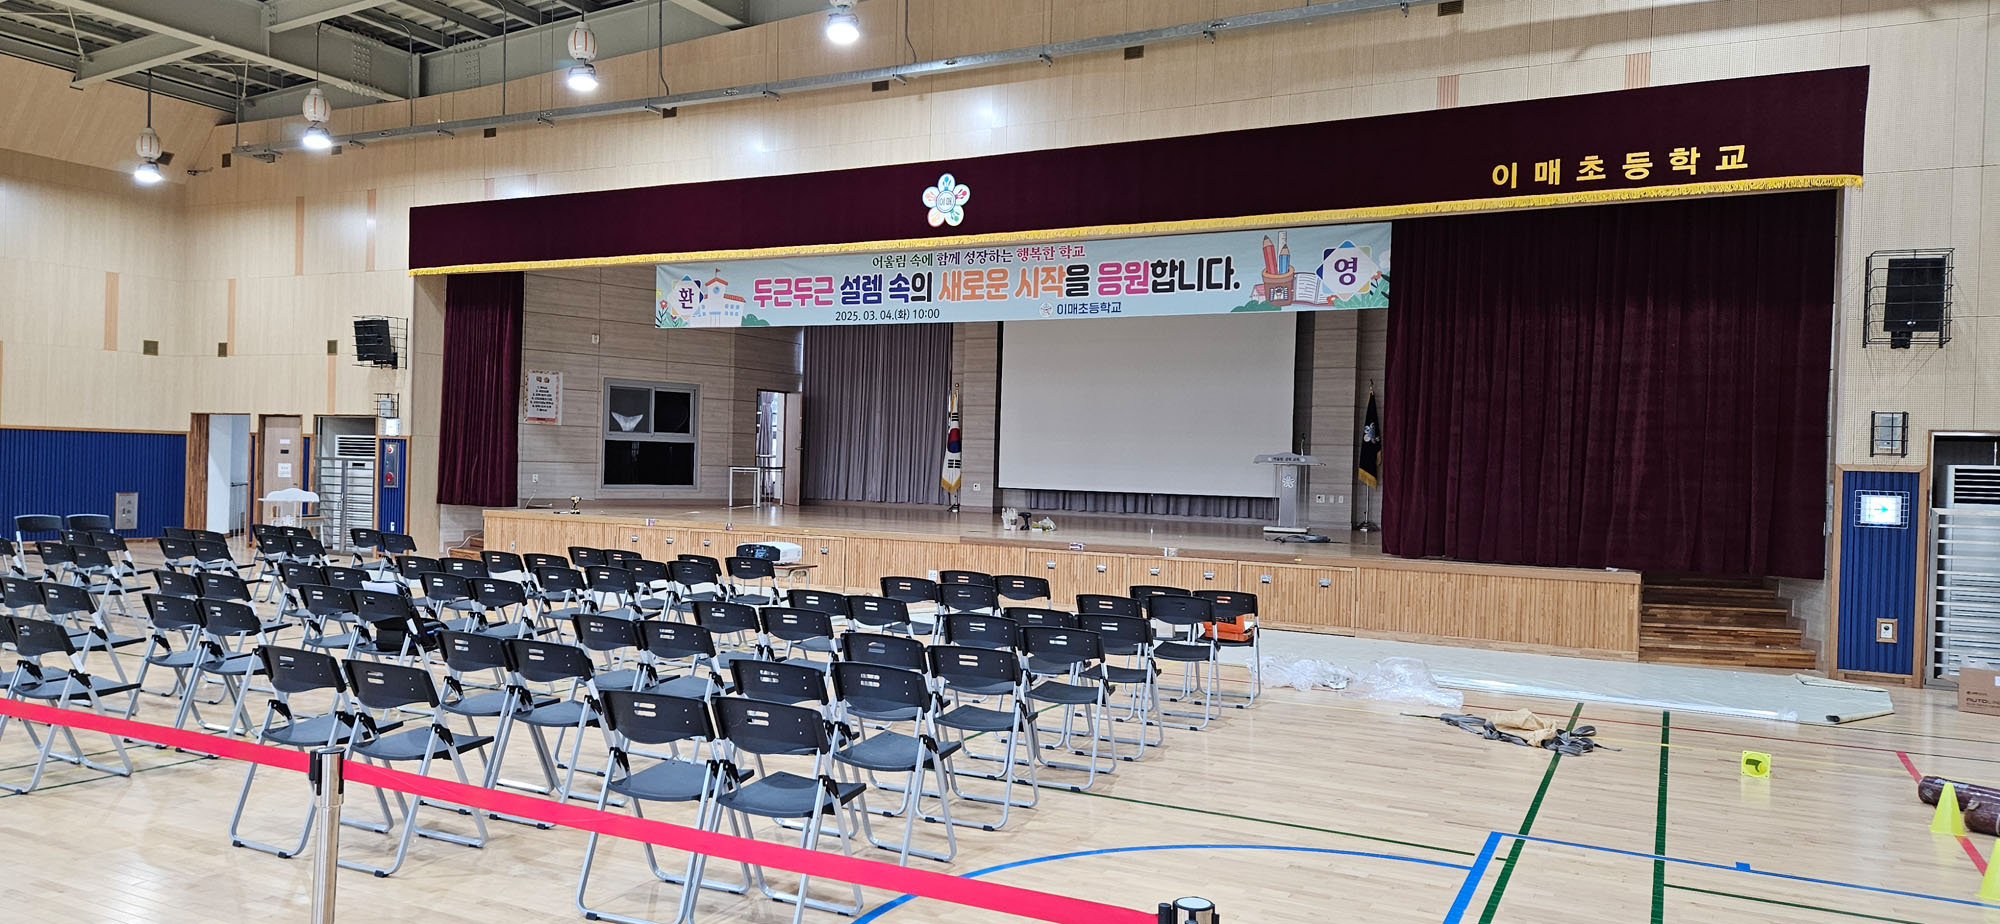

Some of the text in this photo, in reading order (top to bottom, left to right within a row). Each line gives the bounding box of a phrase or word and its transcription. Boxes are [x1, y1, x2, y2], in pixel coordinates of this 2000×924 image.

[872, 245, 1086, 269] 어울림 속에 함께 성장하는 행복한 학교
[753, 255, 1241, 308] 두근두근 설렘 속의 새로운 시작을 응원합니다.
[1333, 256, 1358, 286] 영
[678, 287, 694, 310] 환
[1056, 301, 1122, 316] 이매초등학교
[835, 308, 940, 322] 2025. 03. 04.(화) 10:00
